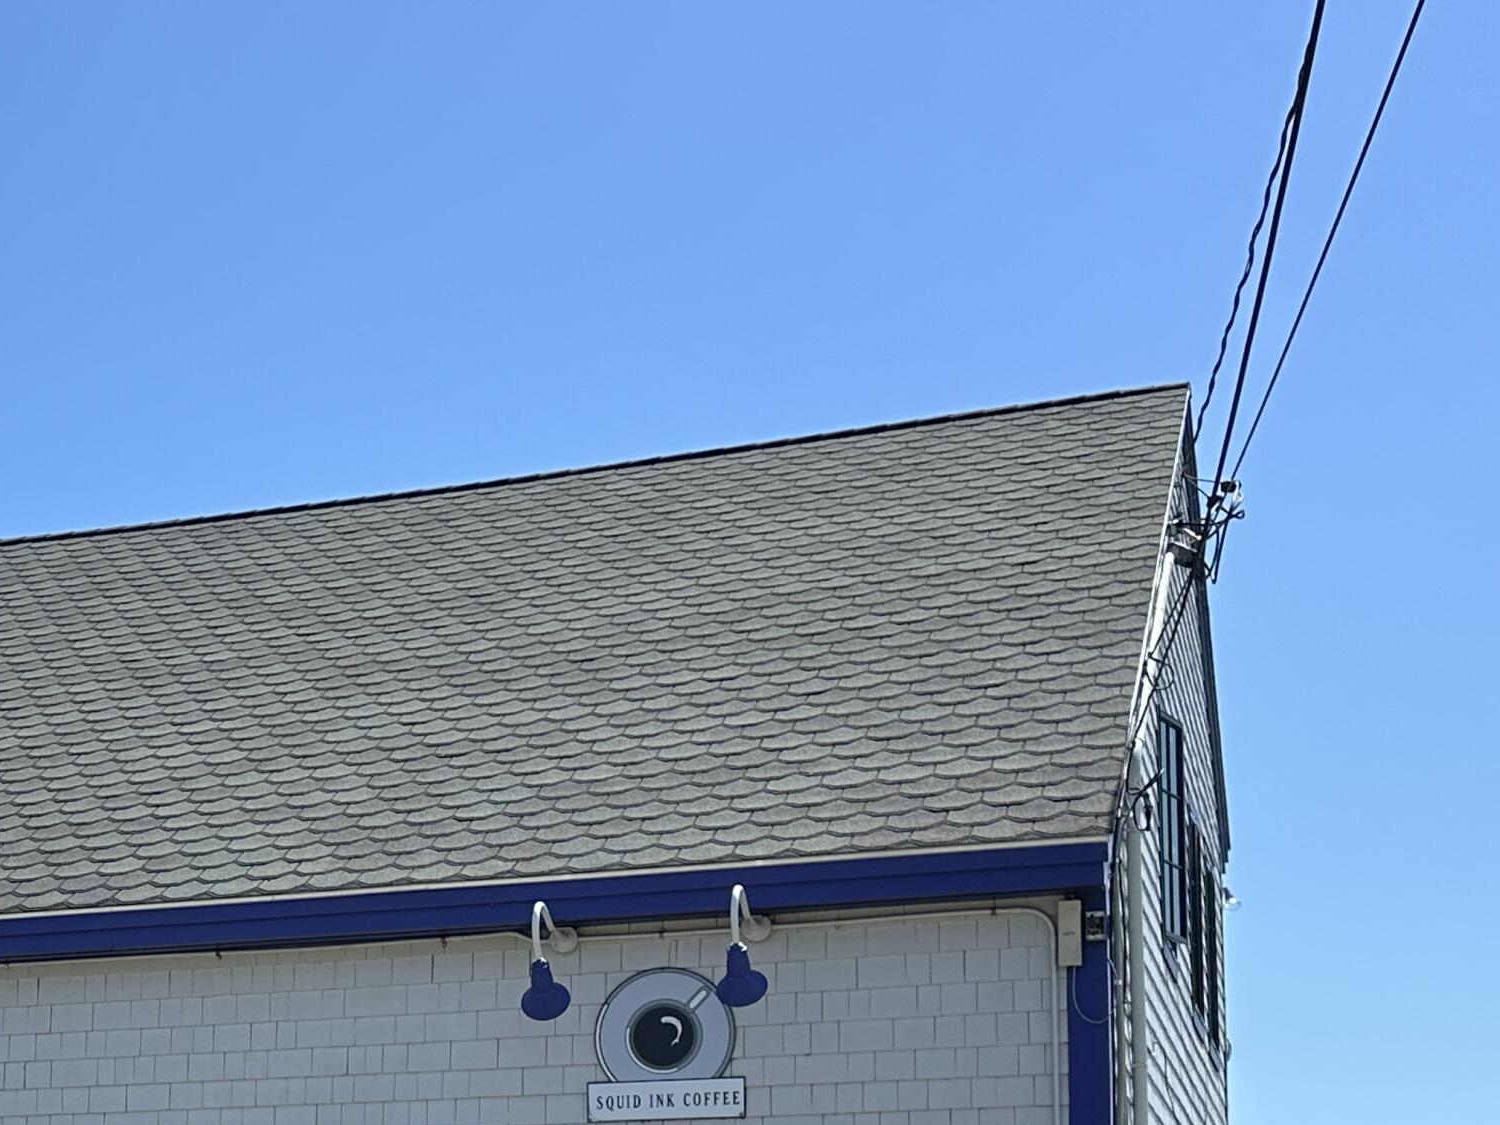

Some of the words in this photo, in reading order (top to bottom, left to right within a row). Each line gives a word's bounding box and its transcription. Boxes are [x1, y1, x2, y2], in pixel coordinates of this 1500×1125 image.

[596, 1094, 641, 1111] SQUID
[649, 1093, 675, 1108] INK
[683, 1090, 741, 1107] COFFEE
